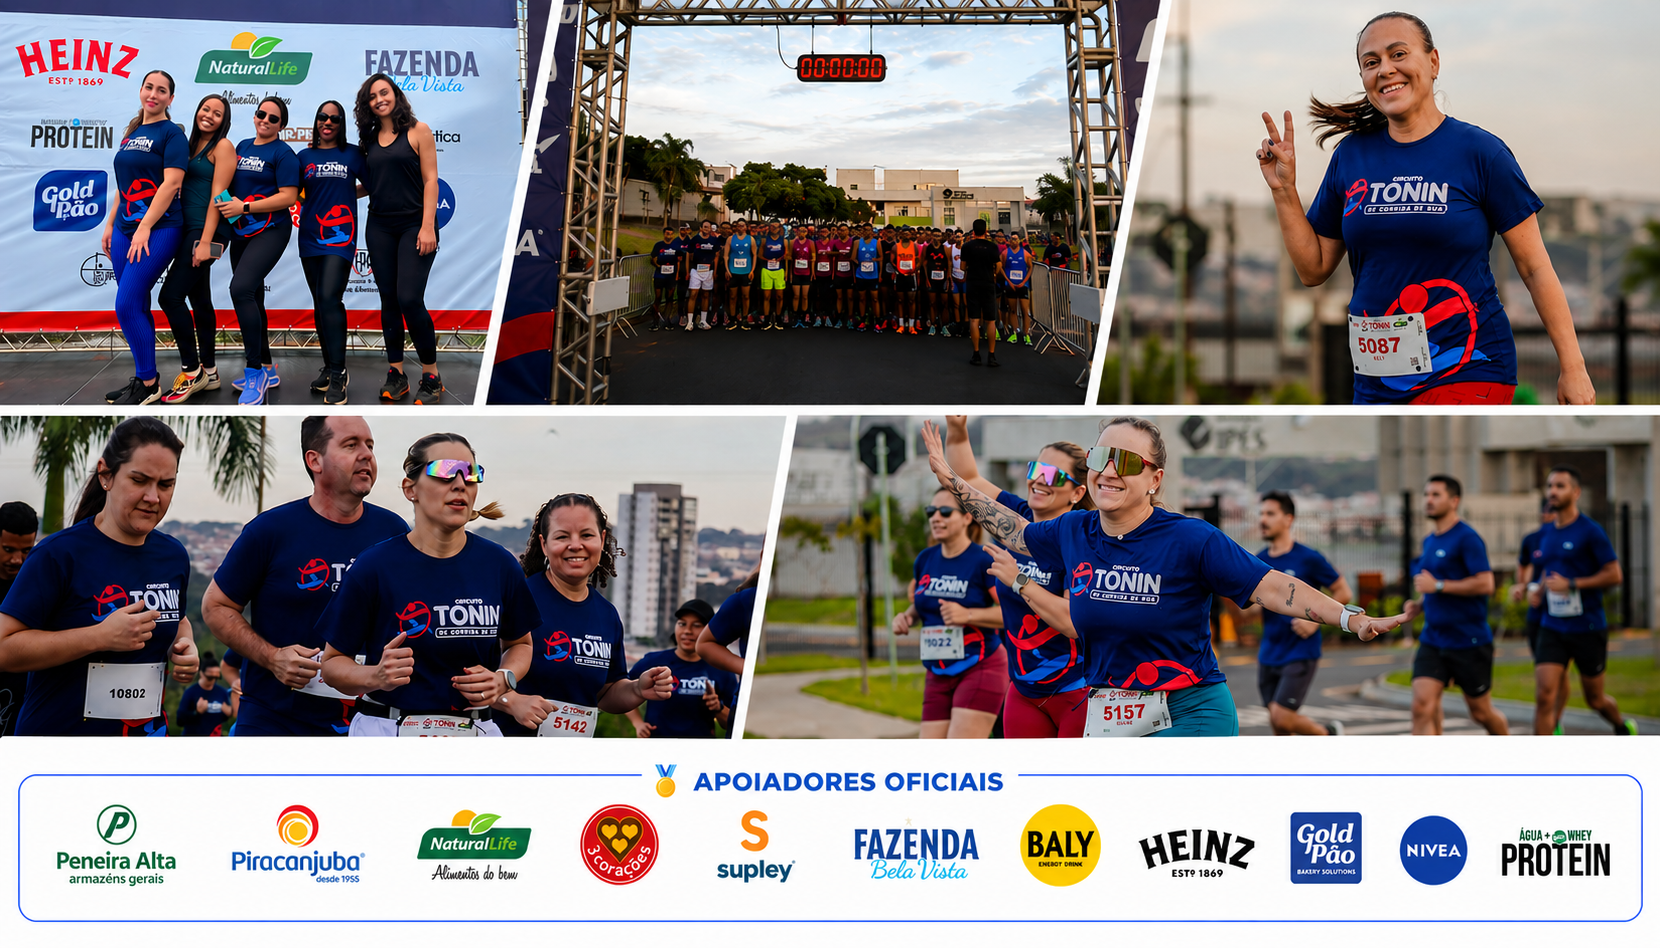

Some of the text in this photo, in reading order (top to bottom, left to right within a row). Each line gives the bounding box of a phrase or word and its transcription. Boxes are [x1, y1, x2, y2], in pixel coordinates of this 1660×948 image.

[15, 38, 140, 79] HEINZ
[365, 49, 480, 77] FAZENDA
[801, 57, 882, 79] 00:00:00
[78, 77, 104, 86] 1869
[420, 74, 465, 92] Vista
[30, 125, 114, 149] PROTEIN
[317, 163, 348, 173] TONIN
[42, 179, 95, 213] Gold
[1370, 181, 1449, 203] TONIN
[56, 200, 99, 220] Pão
[1358, 336, 1401, 354] 5087
[929, 579, 968, 593] TONIN
[1094, 568, 1162, 594] TONIN
[433, 604, 500, 626] TONIN
[109, 688, 146, 699] 10802
[1103, 703, 1146, 721] 5157
[553, 716, 588, 733] 5142
